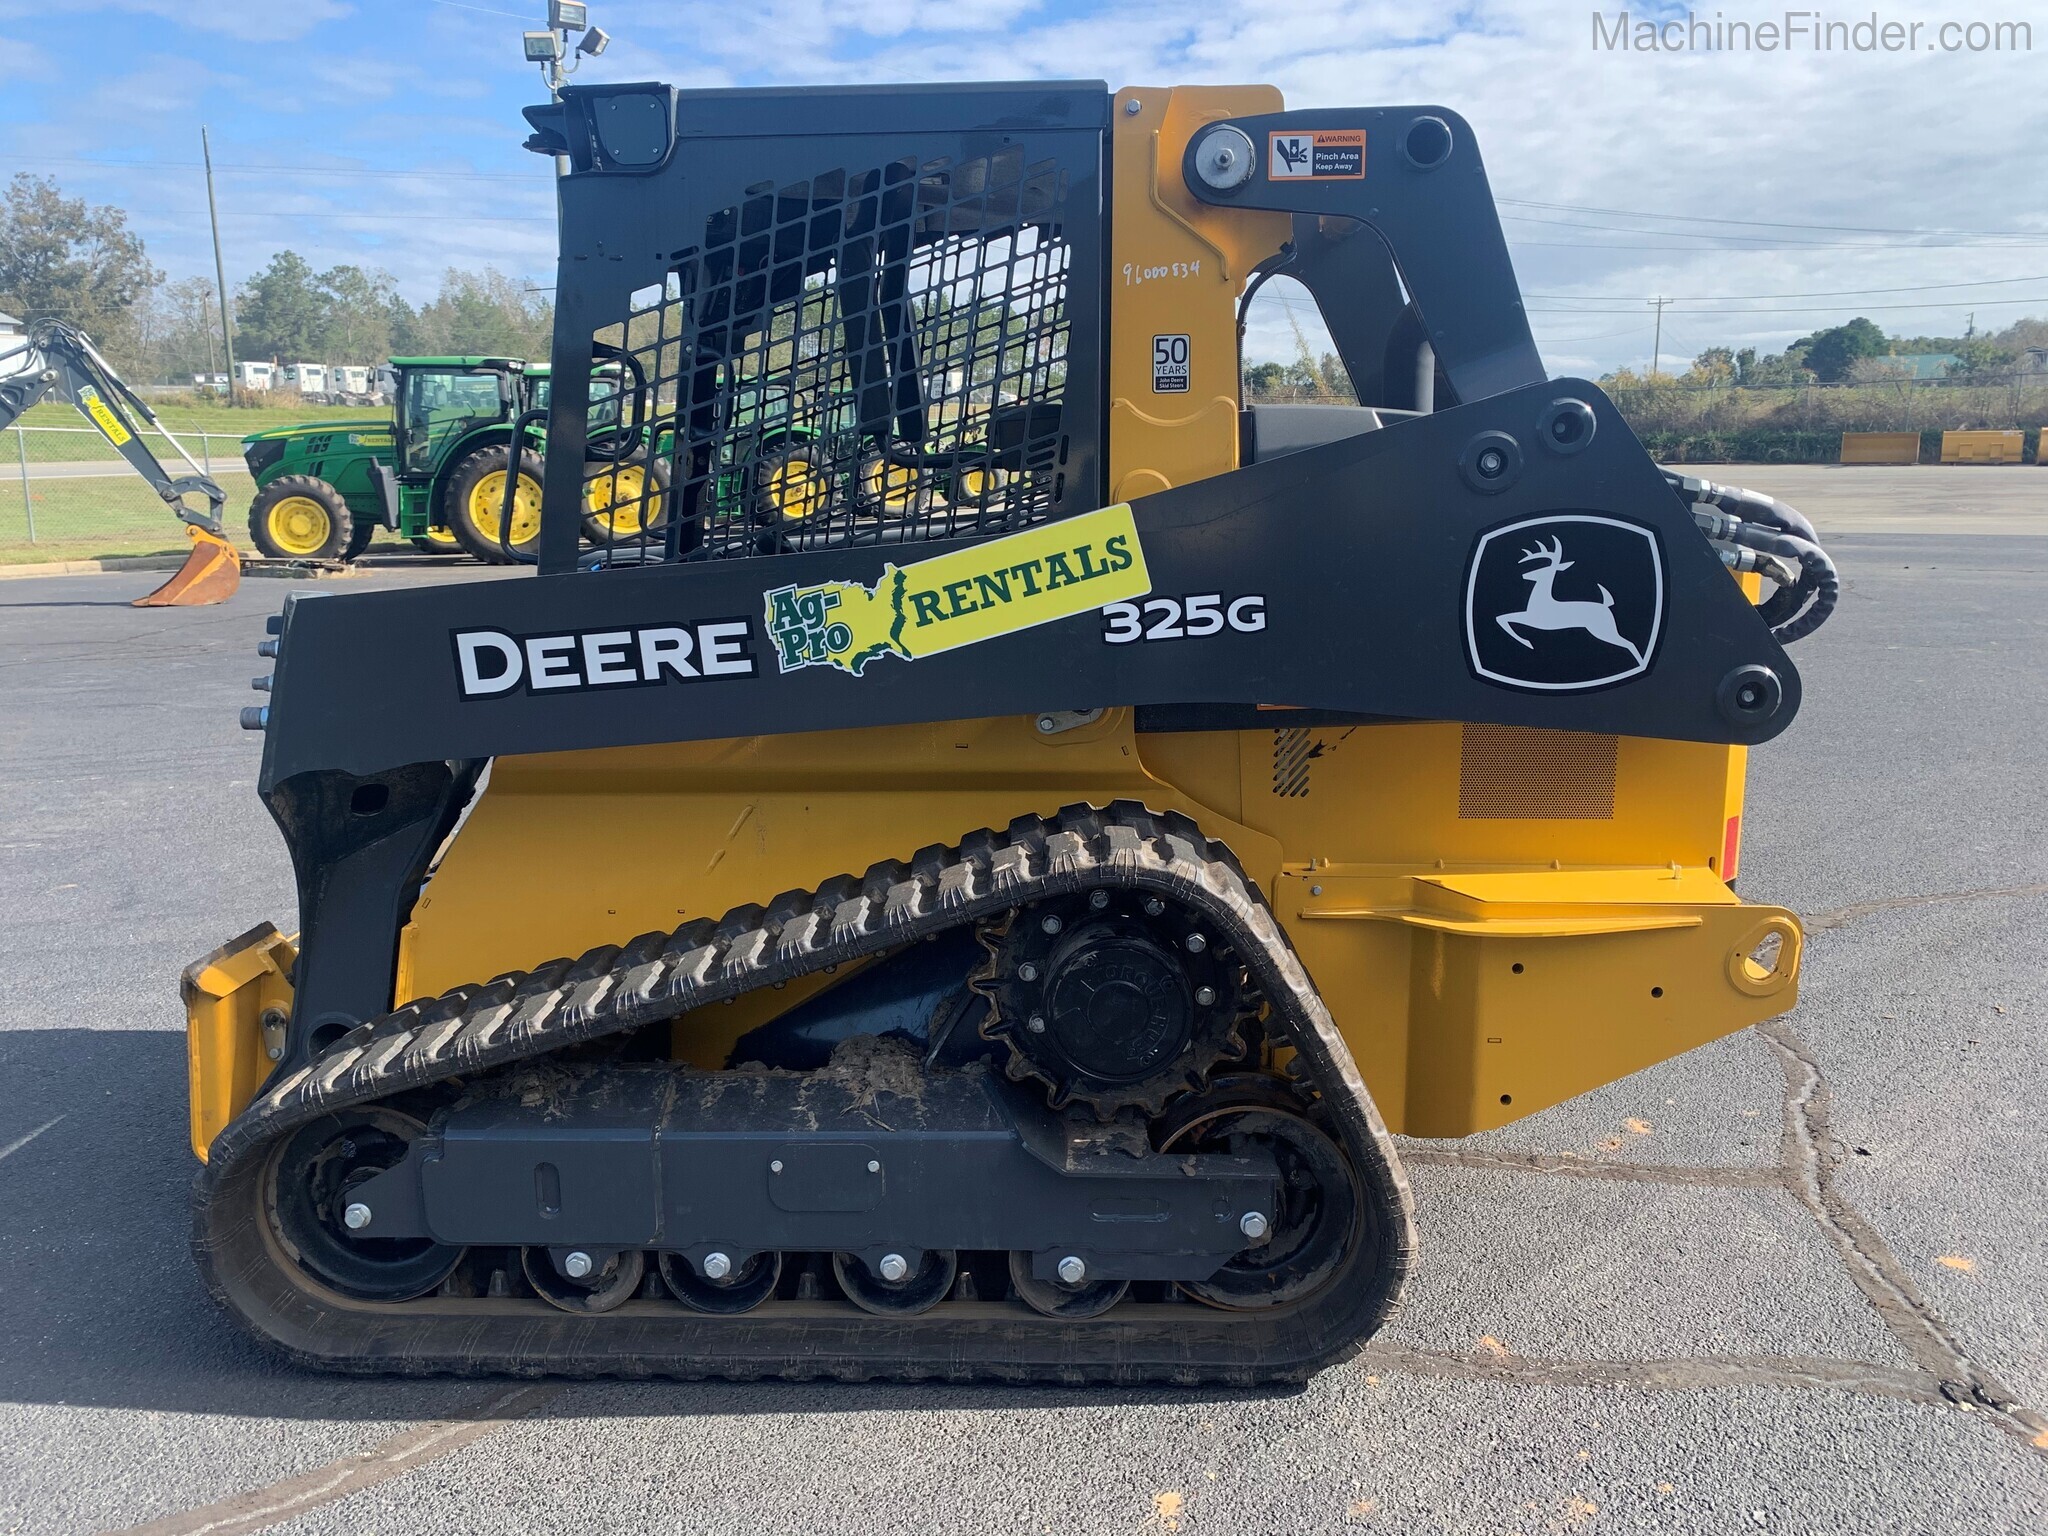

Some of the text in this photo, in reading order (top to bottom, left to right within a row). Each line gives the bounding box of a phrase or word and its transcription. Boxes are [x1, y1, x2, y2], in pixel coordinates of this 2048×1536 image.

[1325, 135, 1361, 143] WARNING
[1315, 163, 1353, 171] Keep Away
[1316, 153, 1338, 161] Pinch
[1155, 337, 1187, 364] 50
[1155, 365, 1187, 374] YEARS
[96, 408, 126, 442] RENTALS
[909, 534, 1133, 627] RENTALS
[771, 588, 841, 632] Ag-
[1104, 596, 1266, 644] 325G
[456, 622, 753, 695] DEERE
[779, 615, 853, 669] Pro
